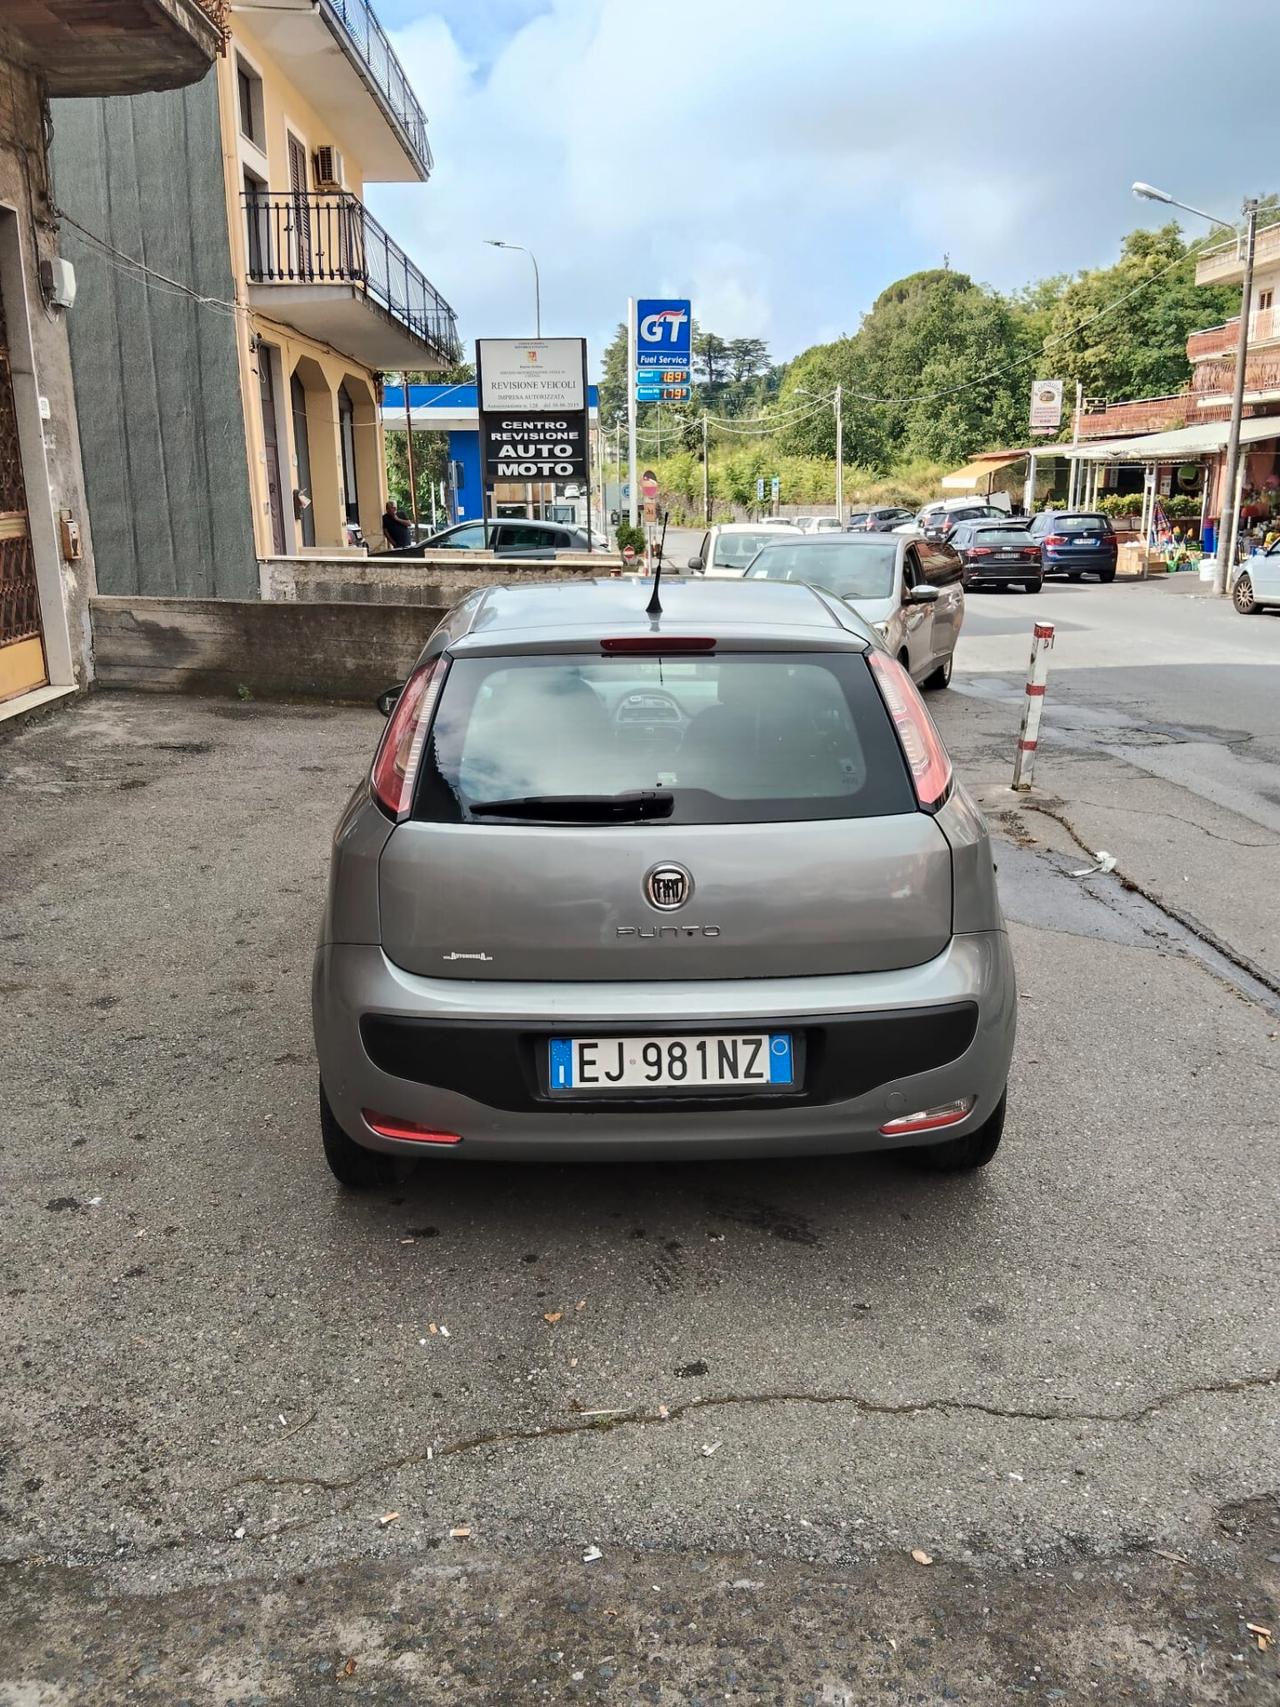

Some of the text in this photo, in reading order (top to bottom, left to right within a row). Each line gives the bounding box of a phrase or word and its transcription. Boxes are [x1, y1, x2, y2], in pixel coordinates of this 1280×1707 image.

[640, 311, 688, 342] GT
[640, 355, 688, 364] Fuel Service
[491, 380, 576, 390] REVISIONE VEICOLI
[501, 421, 568, 430] CENTRO
[491, 432, 579, 440] REVISIONE
[498, 444, 573, 458] AUTO
[497, 463, 574, 476] MOTO
